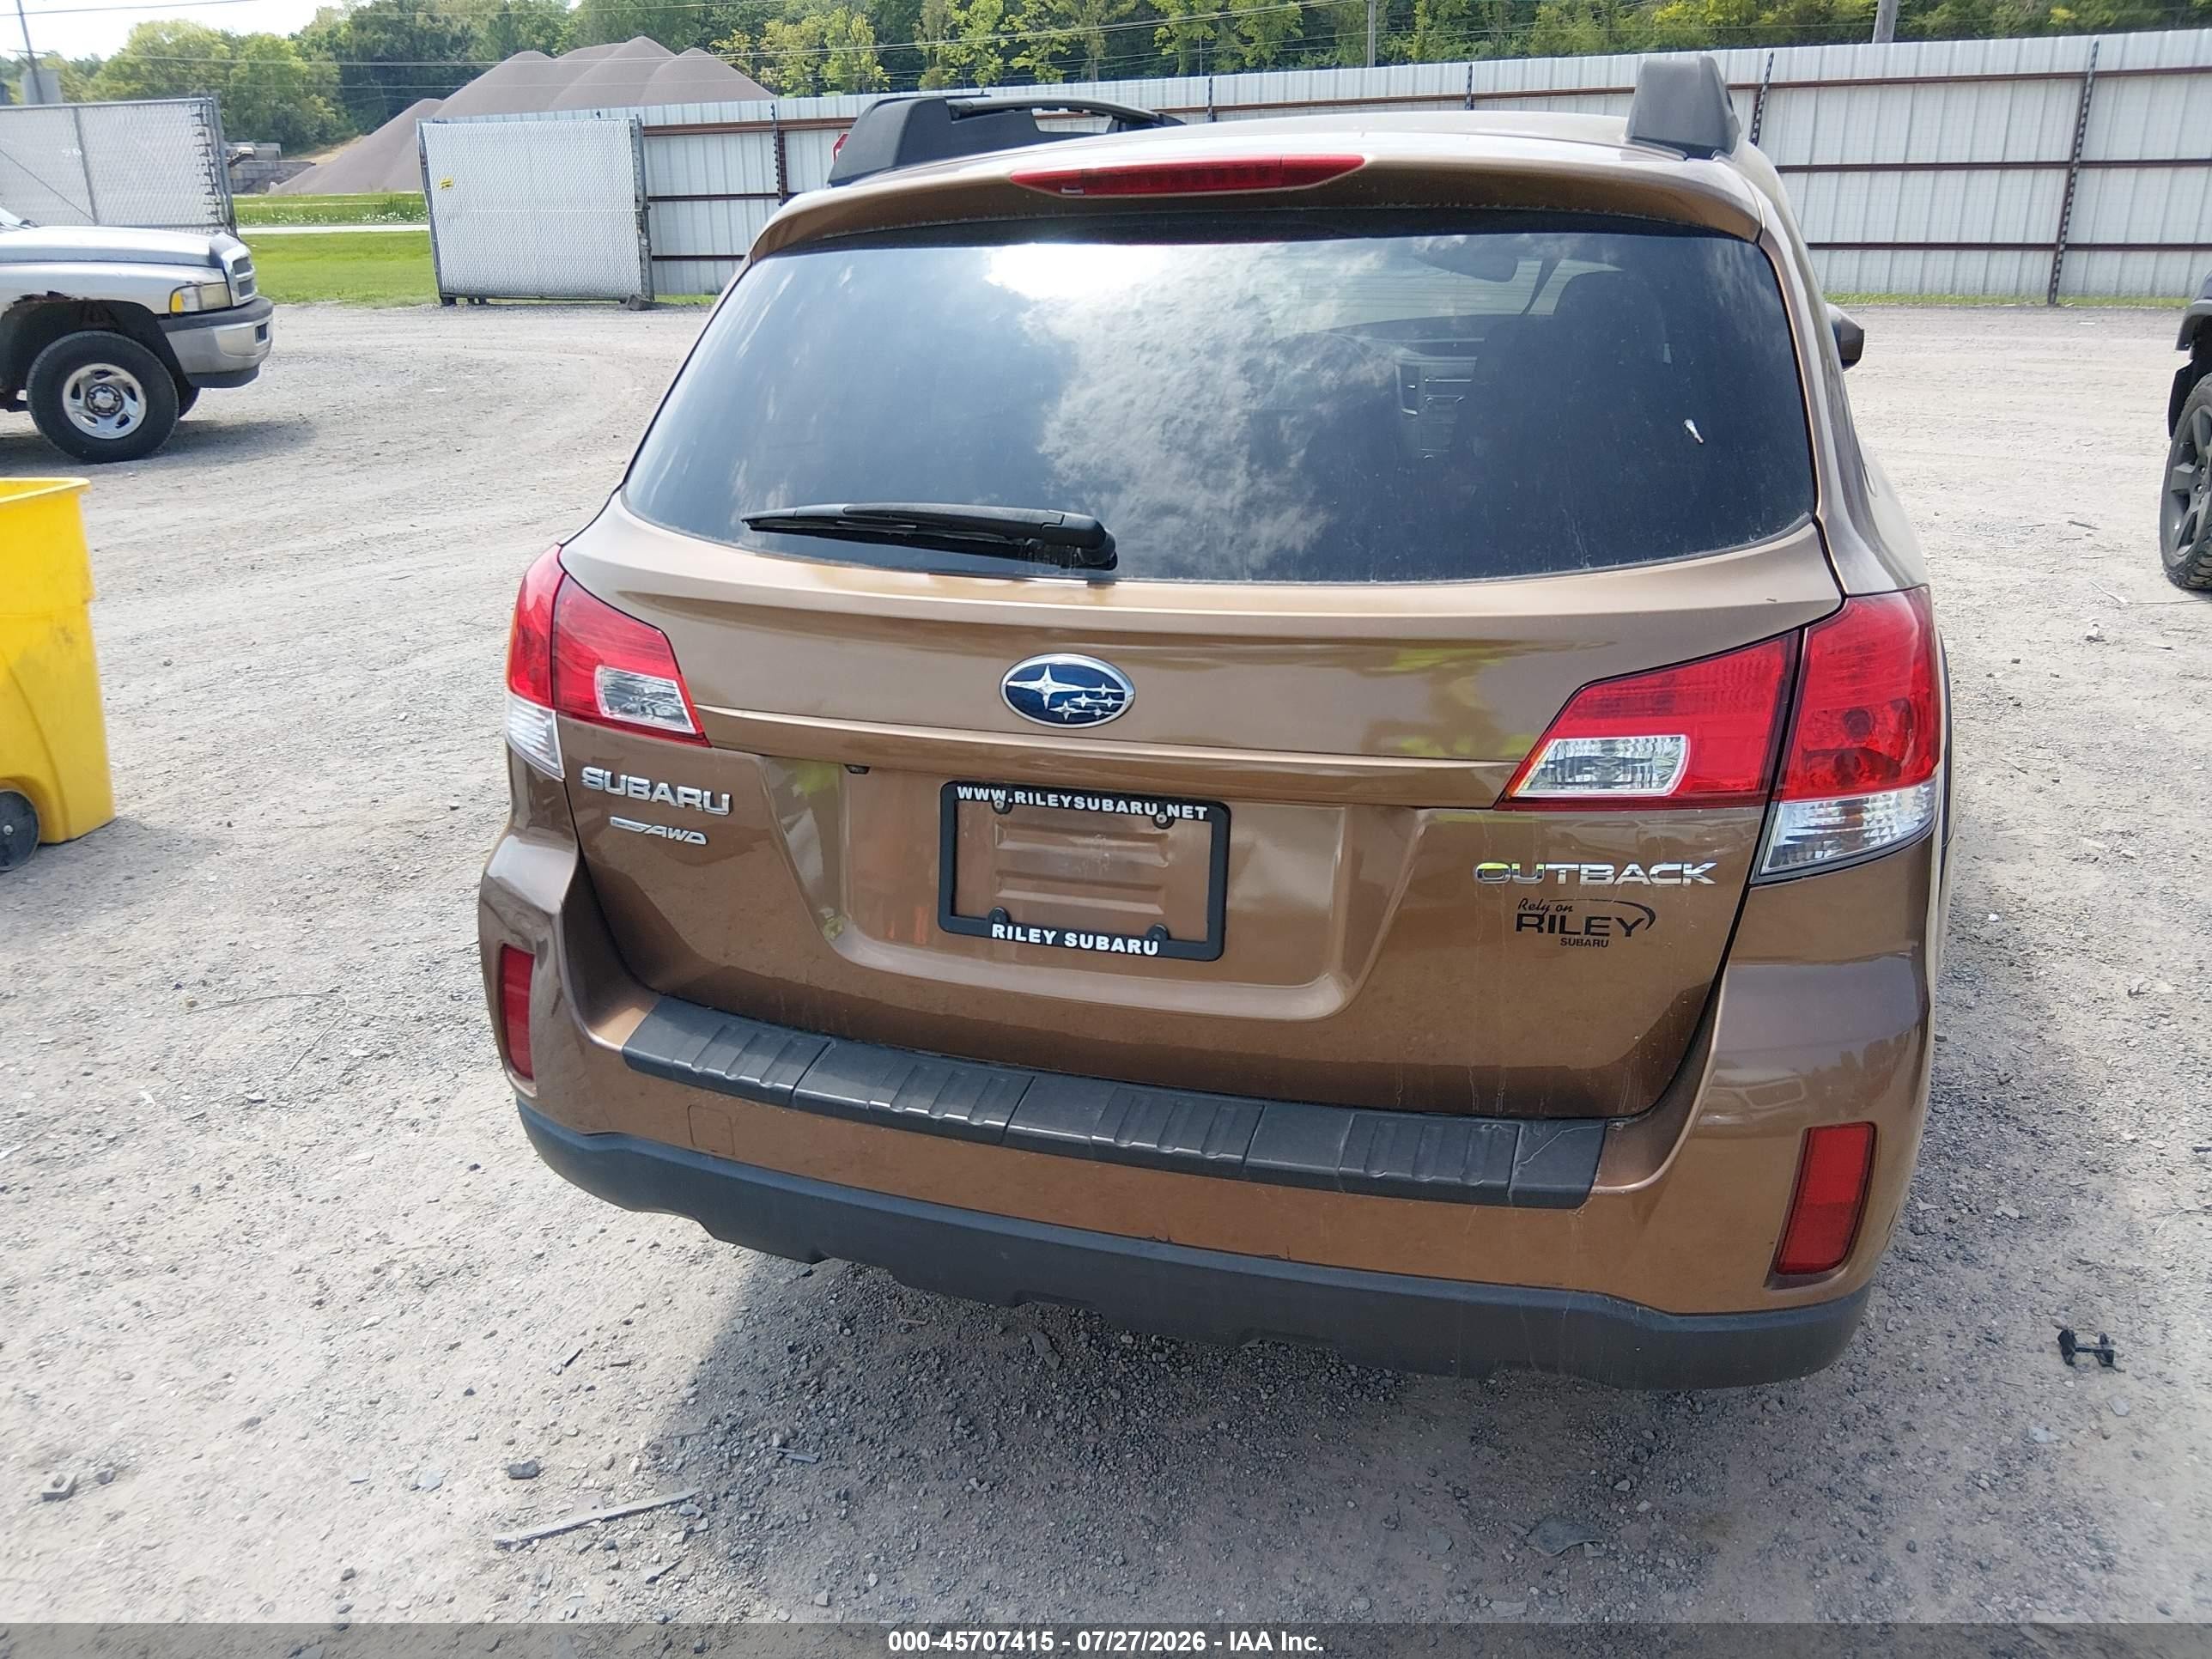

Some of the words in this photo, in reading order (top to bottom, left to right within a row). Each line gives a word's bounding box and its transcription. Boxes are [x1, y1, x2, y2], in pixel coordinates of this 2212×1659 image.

[581, 766, 732, 815] SUBARU
[644, 825, 707, 845] AWD
[1474, 861, 1718, 885] OUTBACK
[1517, 898, 1552, 915] Rely
[1555, 904, 1574, 914] on
[1515, 914, 1645, 938] RILEY
[991, 923, 1057, 945] RILEY
[1064, 932, 1159, 956] SUBARU
[1559, 937, 1609, 948] SUBARU
